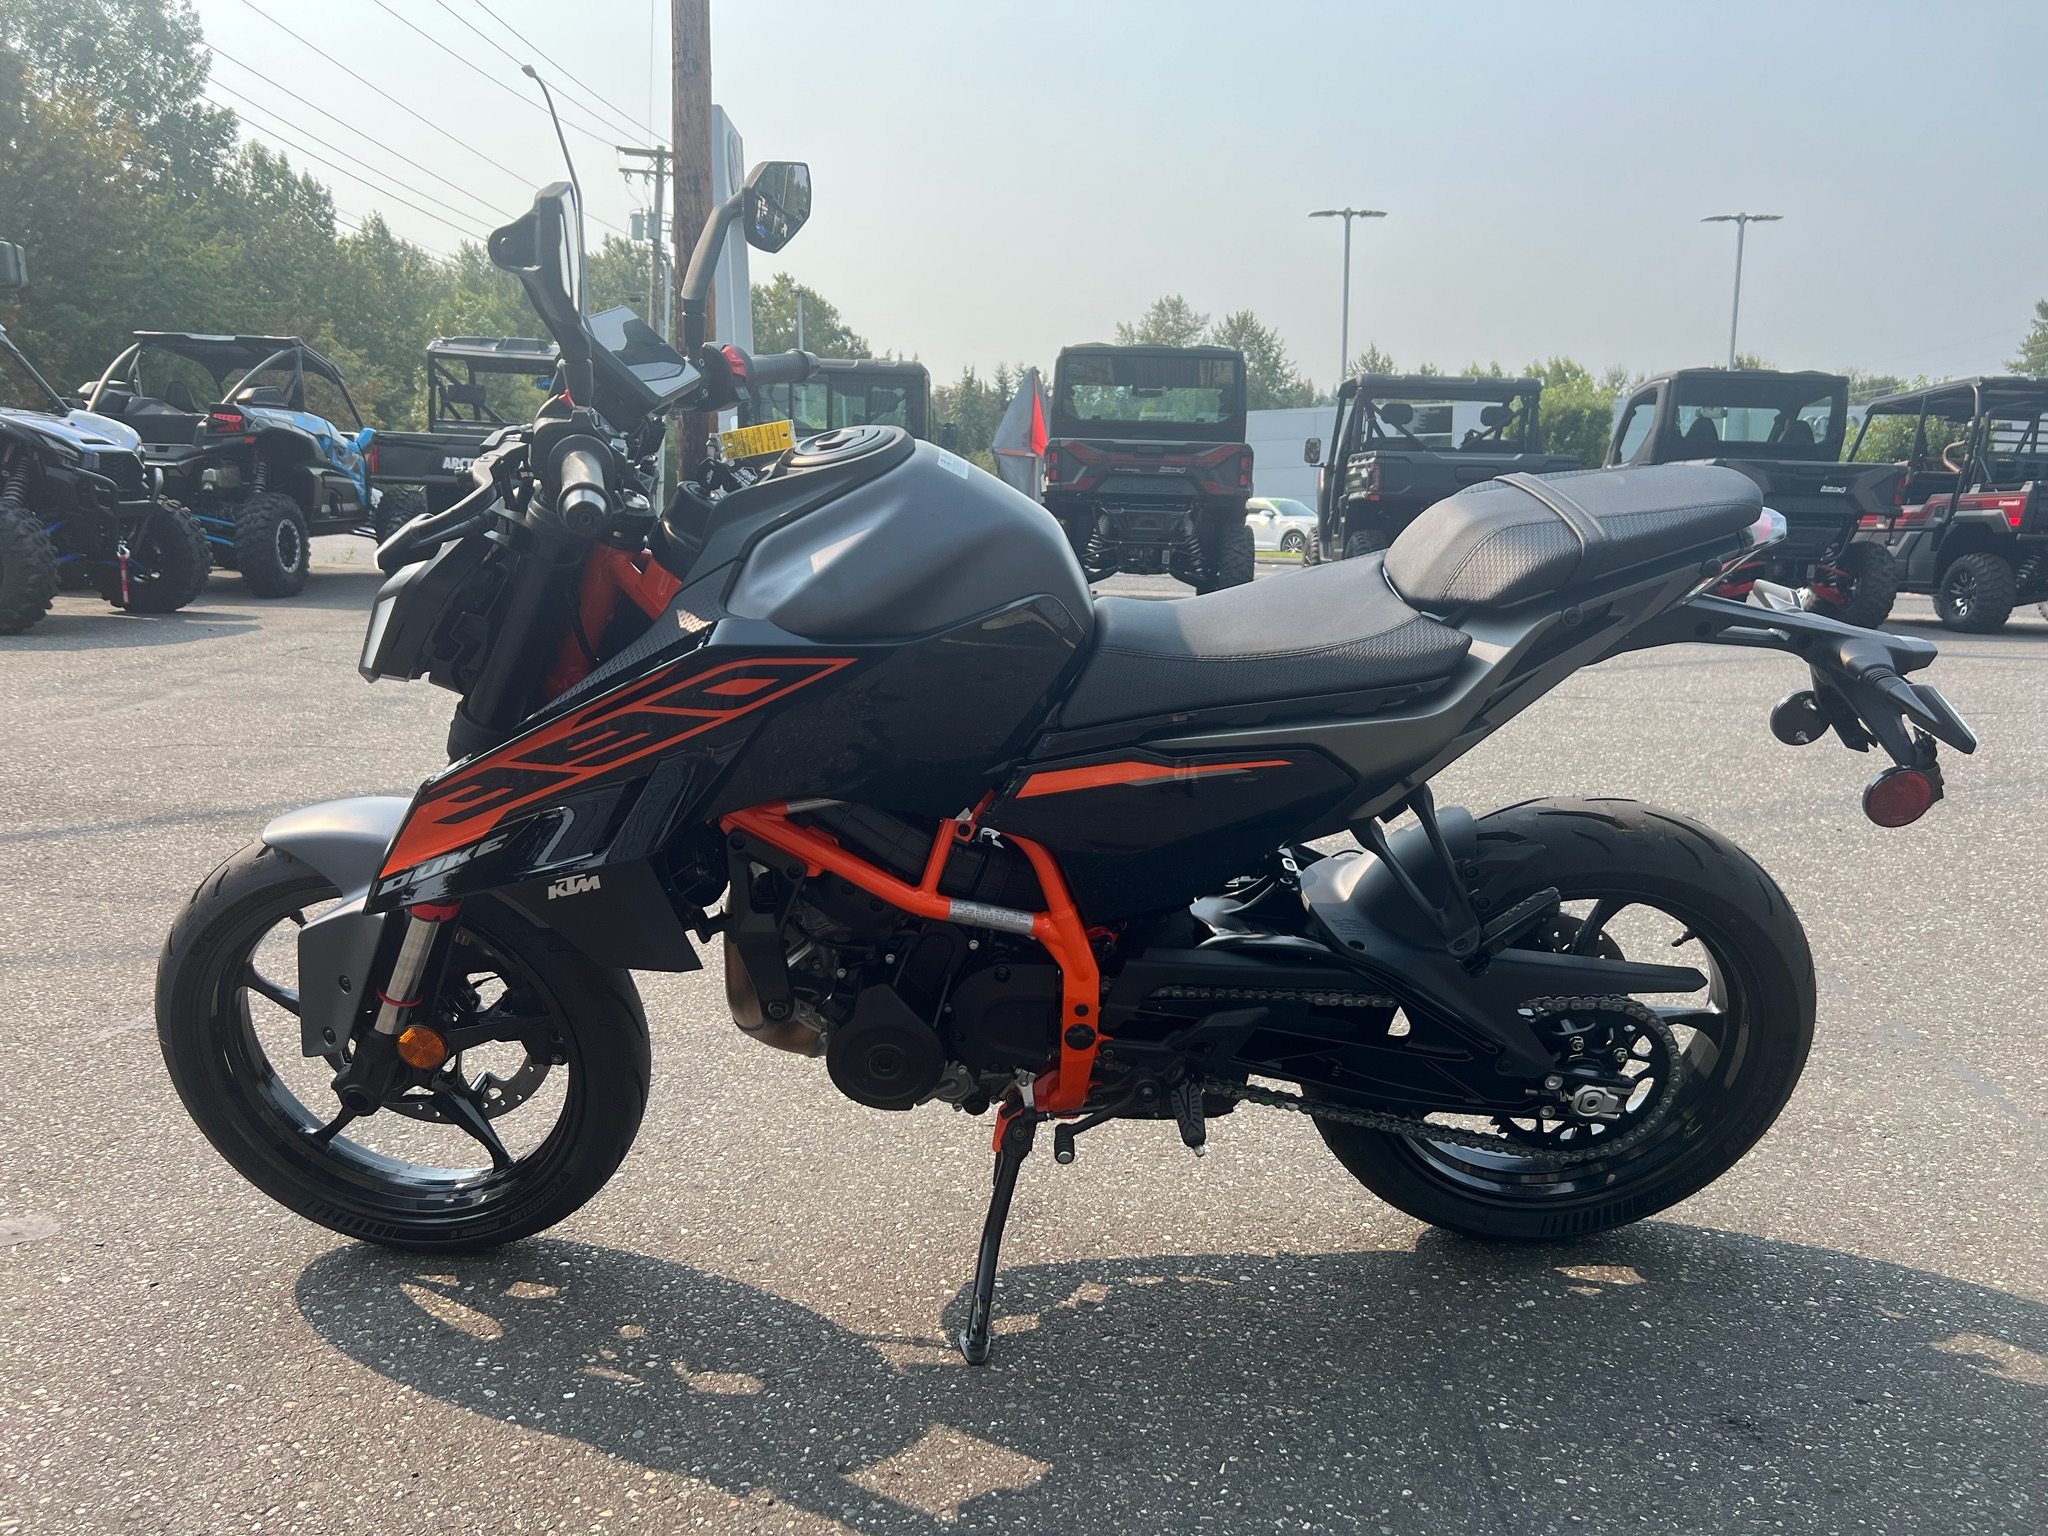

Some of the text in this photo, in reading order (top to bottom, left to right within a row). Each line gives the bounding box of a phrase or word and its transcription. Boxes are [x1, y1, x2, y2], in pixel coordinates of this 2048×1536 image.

[378, 833, 509, 896] DUKE
[548, 873, 601, 900] KTM
[1722, 1066, 1785, 1156] MICHELIN
[508, 1185, 558, 1223] MICHELIN
[462, 1219, 500, 1237] POWER
